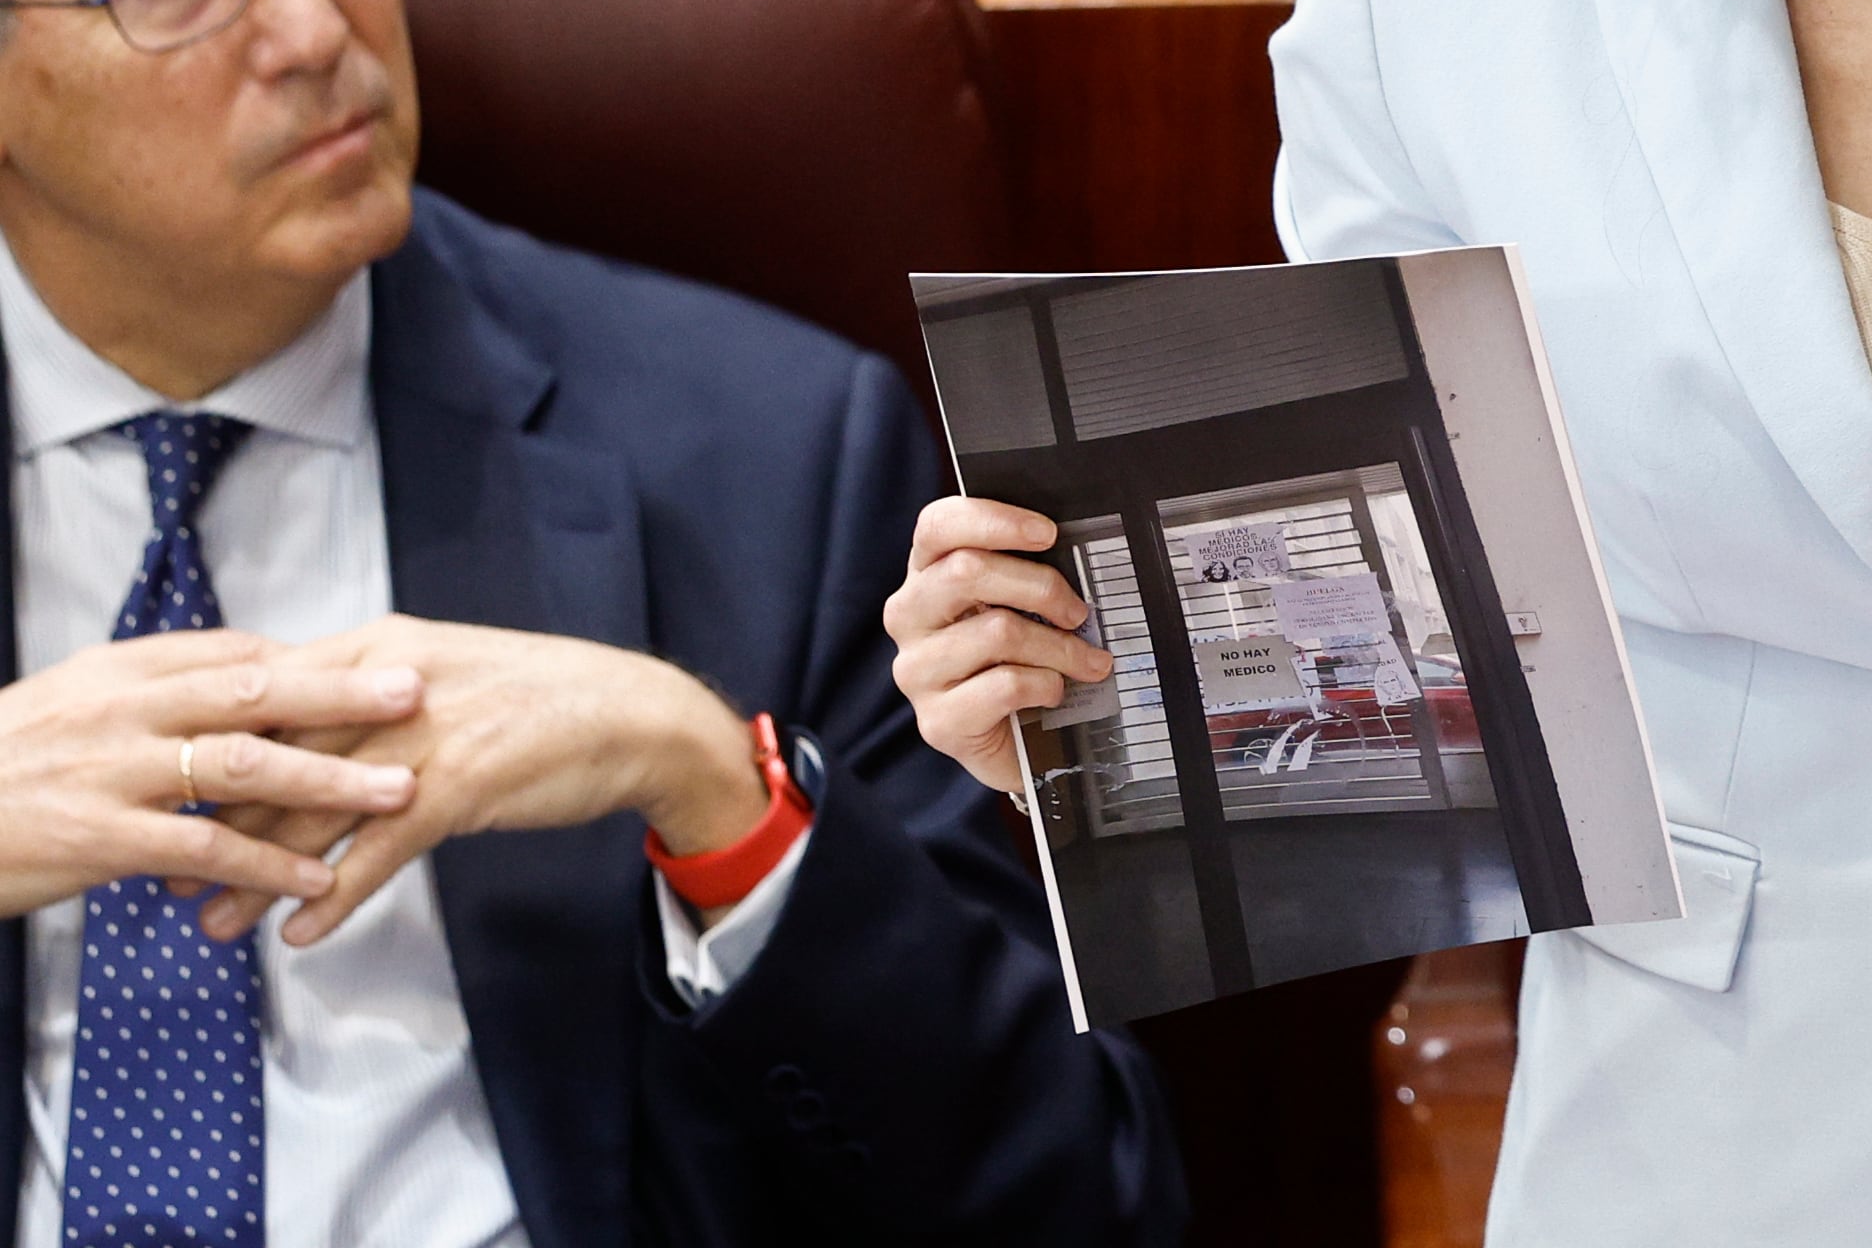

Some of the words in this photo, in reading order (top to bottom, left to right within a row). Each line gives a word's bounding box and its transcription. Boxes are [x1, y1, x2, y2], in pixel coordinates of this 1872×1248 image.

[1228, 527, 1249, 537] HAY
[1199, 541, 1250, 555] MEJORAD
[1203, 543, 1278, 561] CONDICIONES
[1220, 651, 1240, 661] NO
[1244, 648, 1271, 659] HAY
[1224, 664, 1276, 677] MEDICO
